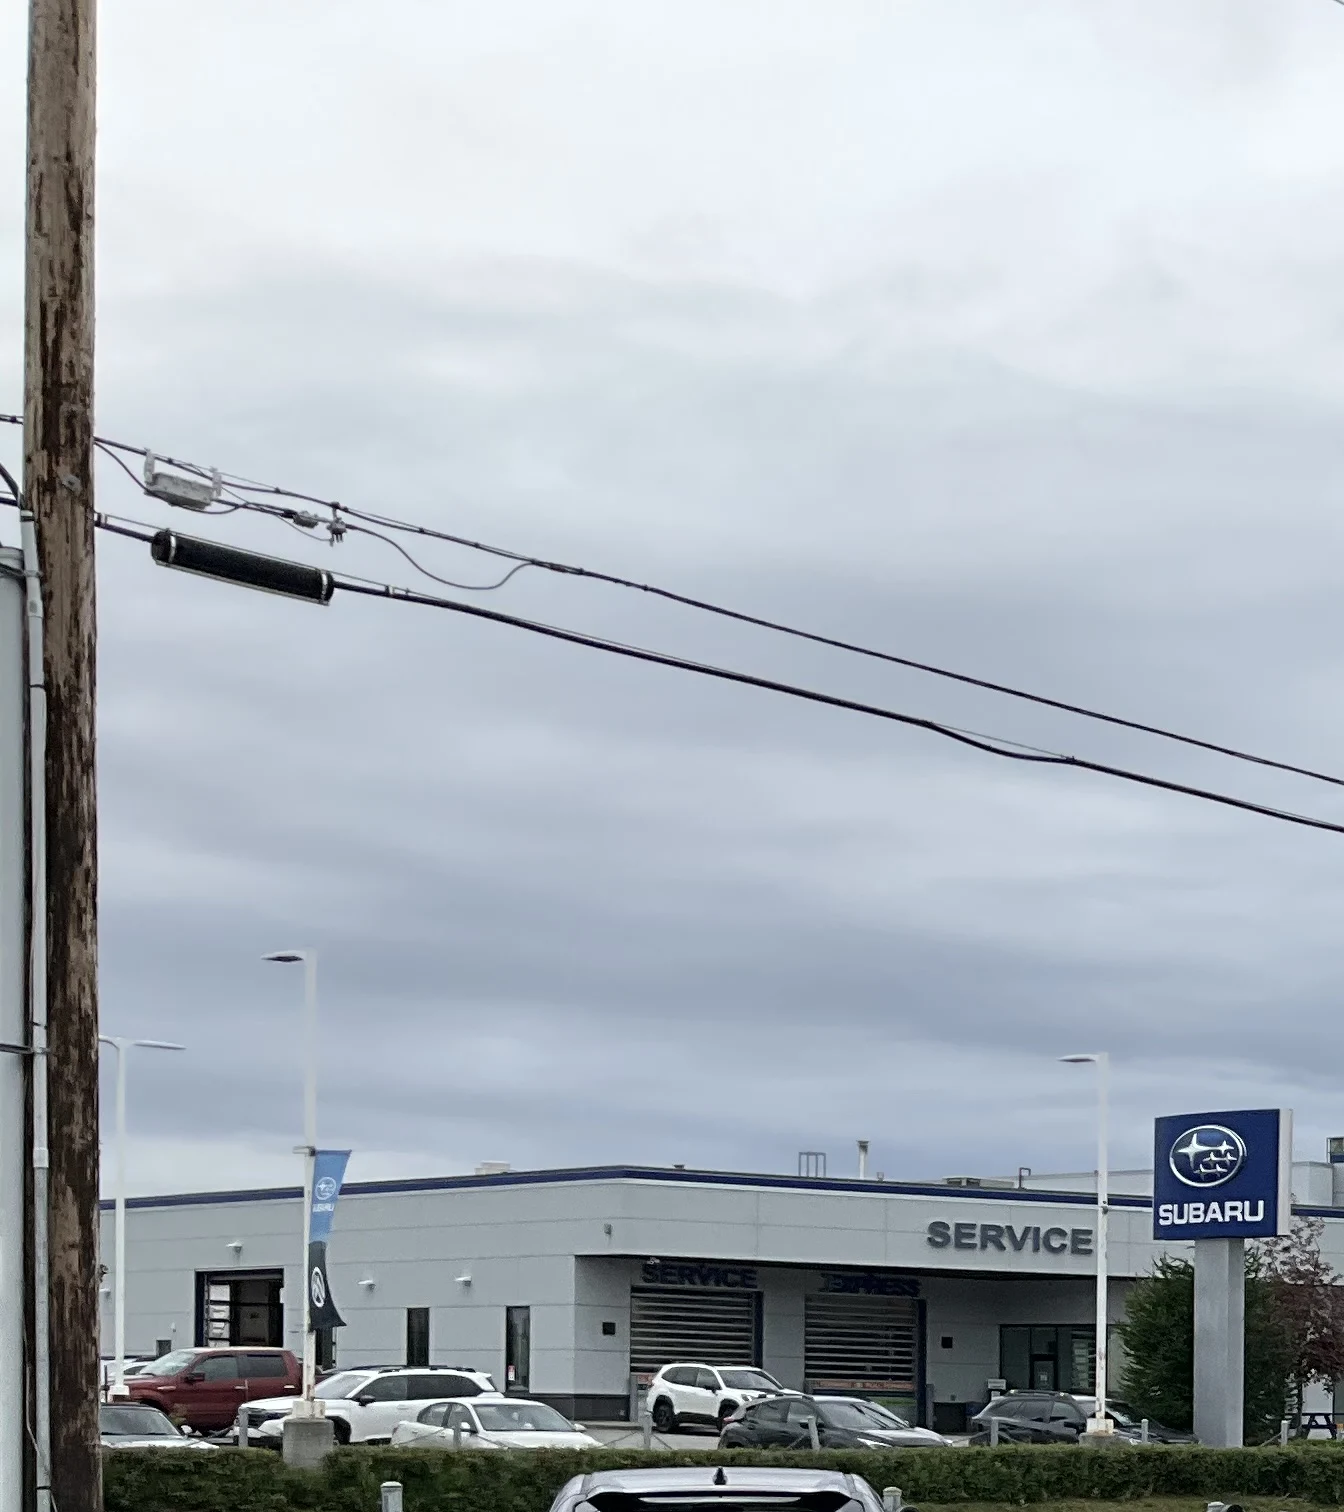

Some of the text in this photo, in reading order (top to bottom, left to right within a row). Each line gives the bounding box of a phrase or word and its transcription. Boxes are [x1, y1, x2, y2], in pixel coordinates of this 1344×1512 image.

[1158, 1199, 1265, 1226] SUBARU
[926, 1220, 1094, 1255] SERVICE
[641, 1261, 759, 1291] SERVICE
